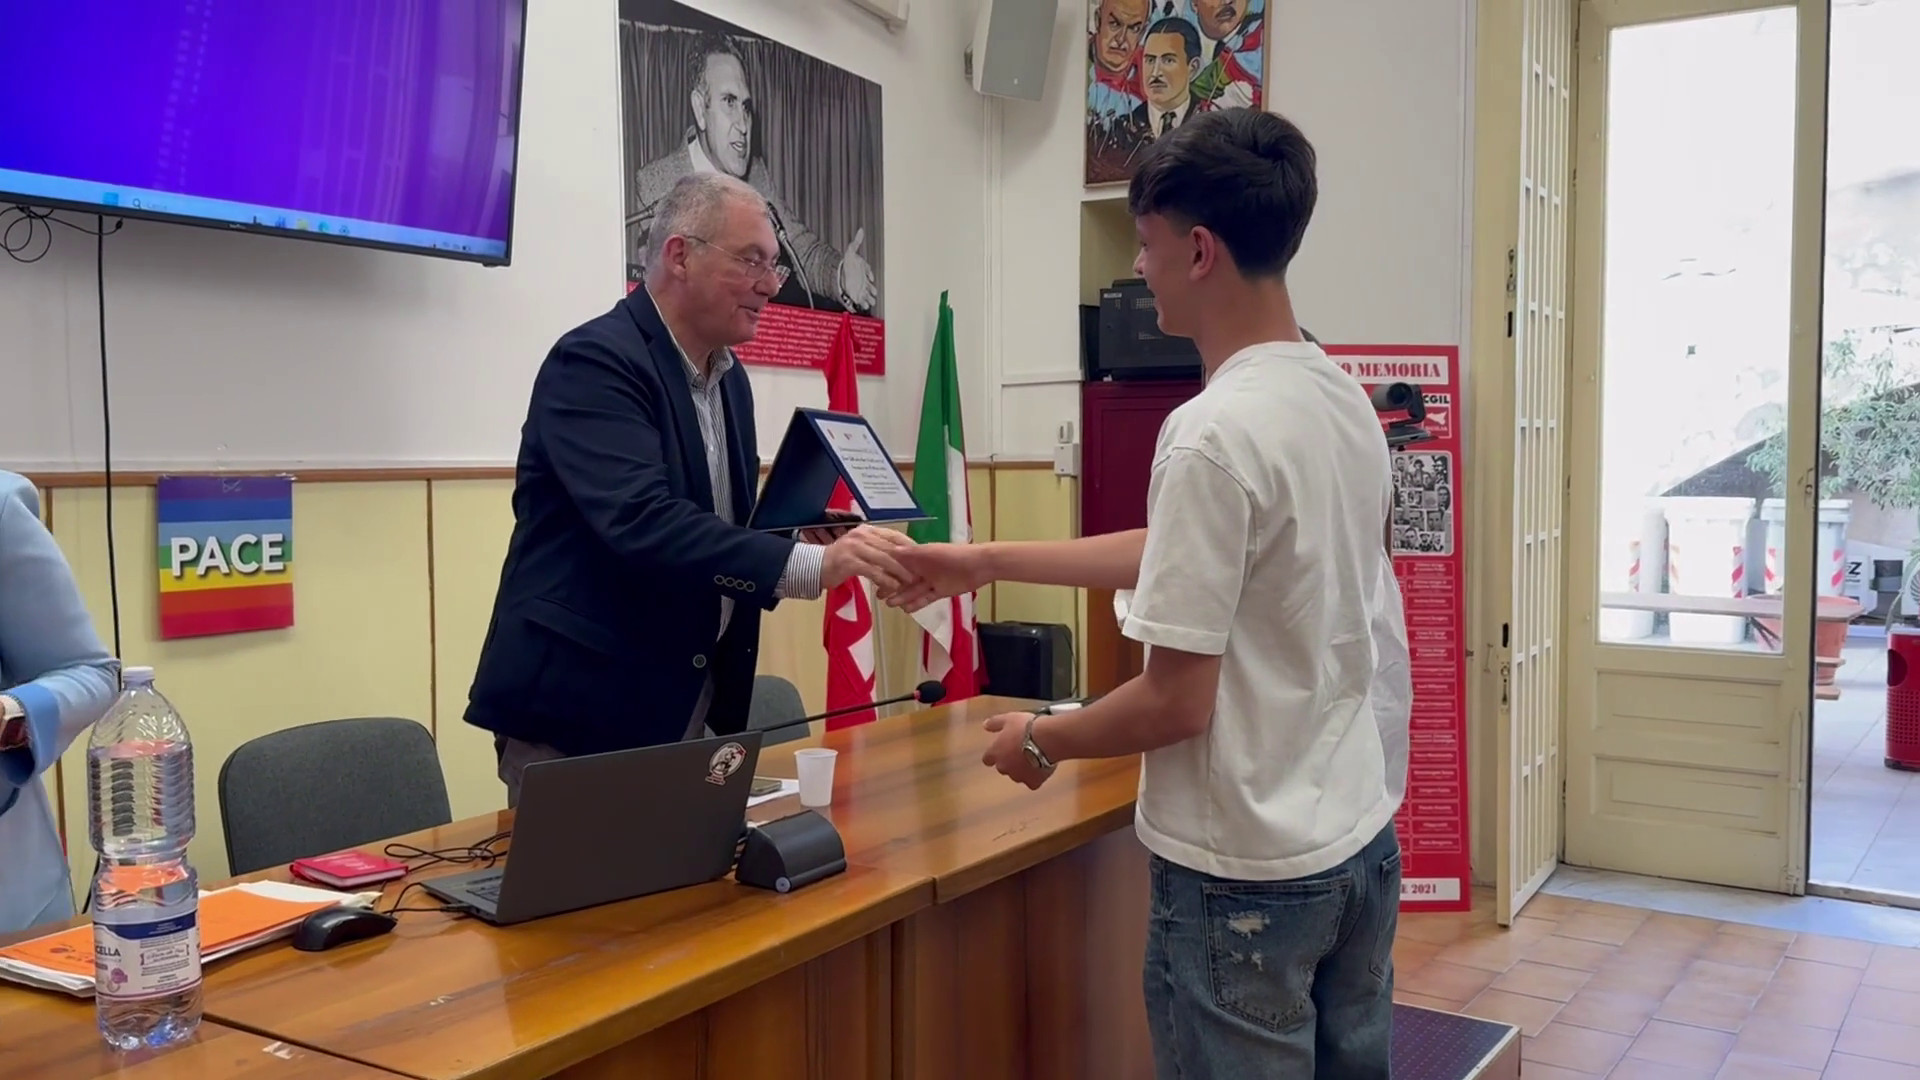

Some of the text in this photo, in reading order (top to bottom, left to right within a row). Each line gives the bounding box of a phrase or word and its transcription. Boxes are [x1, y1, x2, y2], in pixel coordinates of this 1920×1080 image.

[1357, 363, 1441, 377] MEMORIA
[1422, 394, 1450, 404] CGIL
[171, 532, 285, 577] PACE
[1411, 883, 1437, 894] 2021
